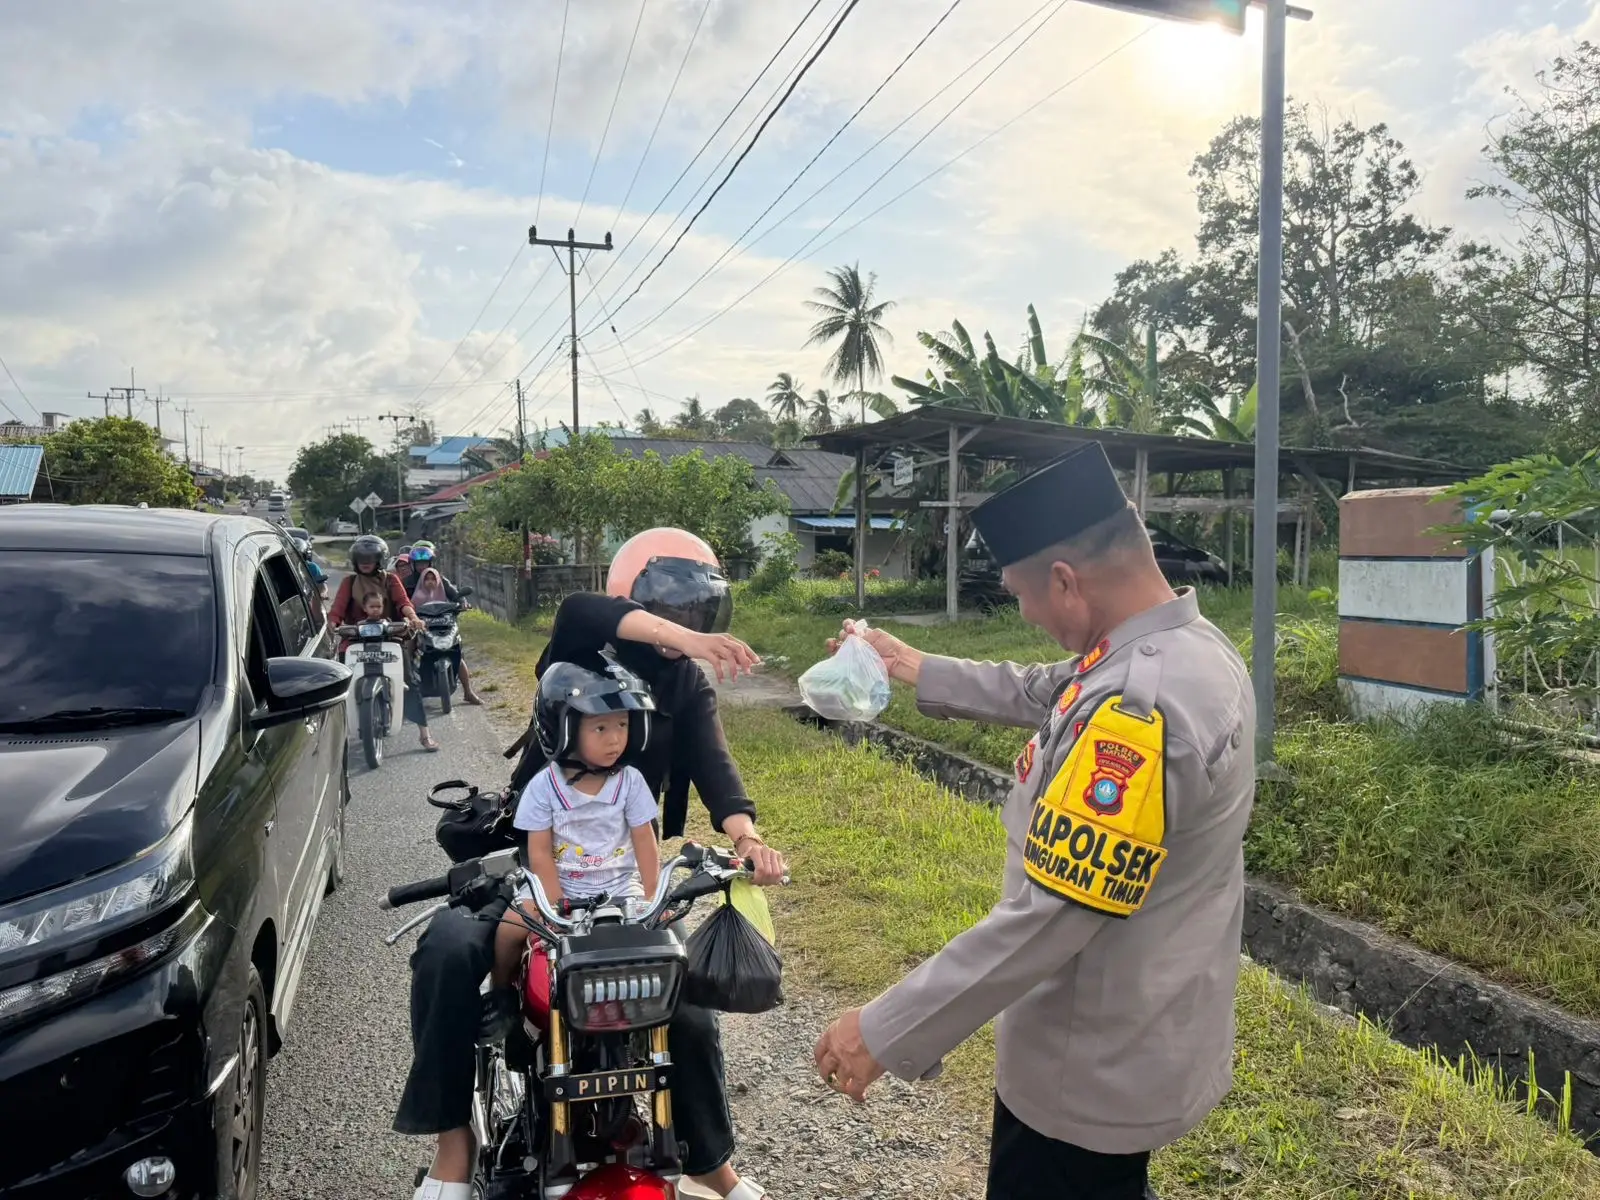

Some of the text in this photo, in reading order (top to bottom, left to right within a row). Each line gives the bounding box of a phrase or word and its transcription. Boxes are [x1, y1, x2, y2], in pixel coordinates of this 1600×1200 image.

[1100, 741, 1140, 761] POLRES
[1029, 802, 1160, 883] KAPOLSEK
[1023, 837, 1145, 905] UNGURAN TIMUR
[579, 1073, 646, 1095] PIPIN
